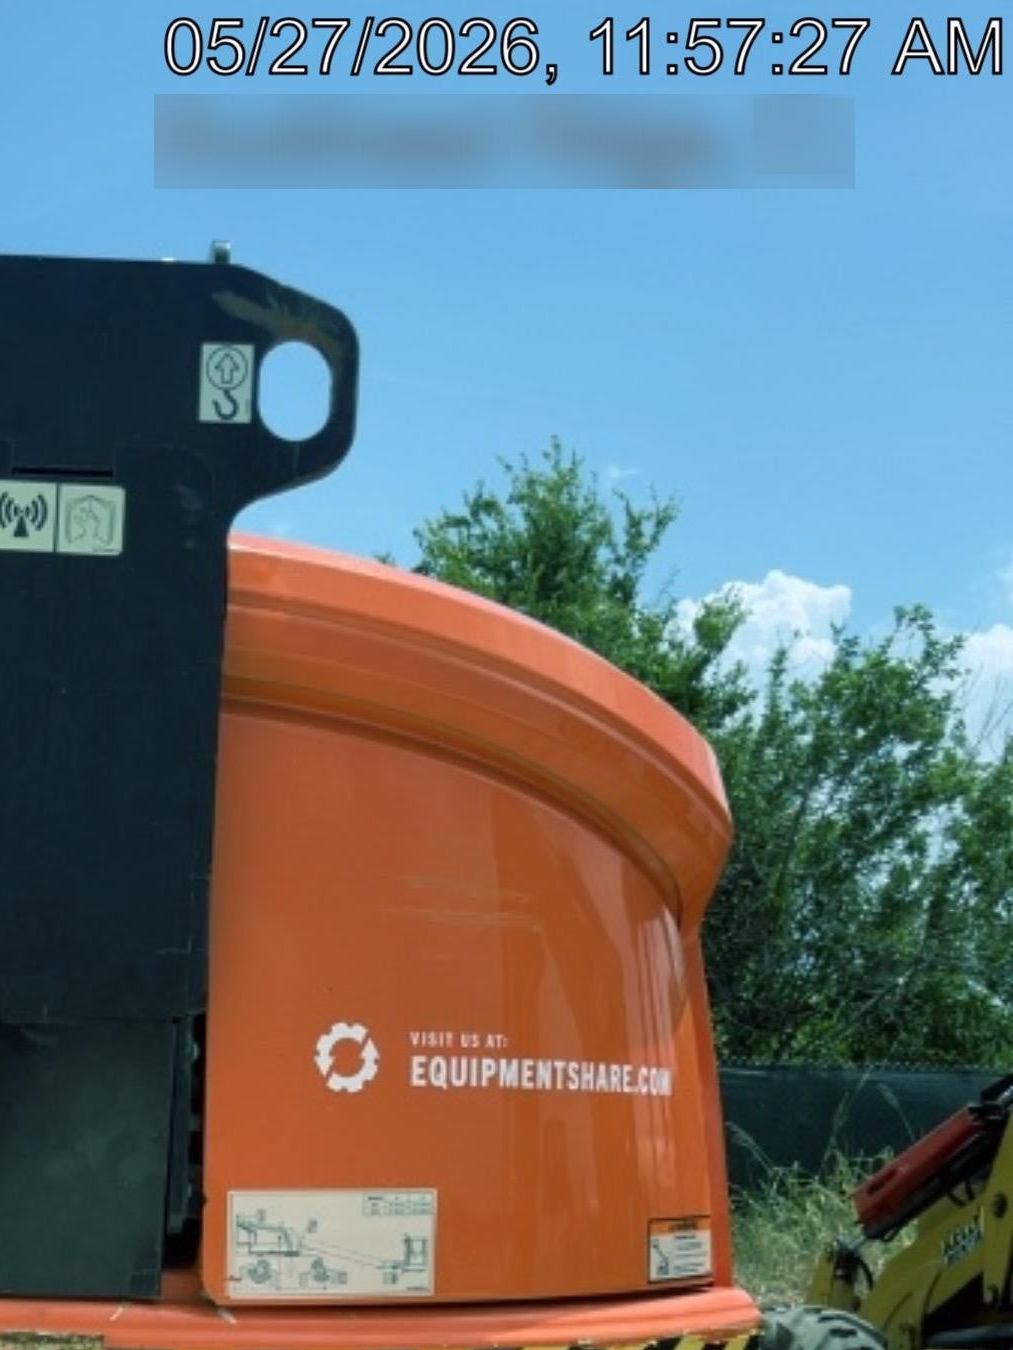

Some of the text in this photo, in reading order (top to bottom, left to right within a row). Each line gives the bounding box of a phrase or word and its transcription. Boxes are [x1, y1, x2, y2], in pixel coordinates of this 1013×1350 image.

[409, 1030, 509, 1049] VISIT US AT:
[410, 1055, 673, 1097] EQUIPMENTSHARE.COM
